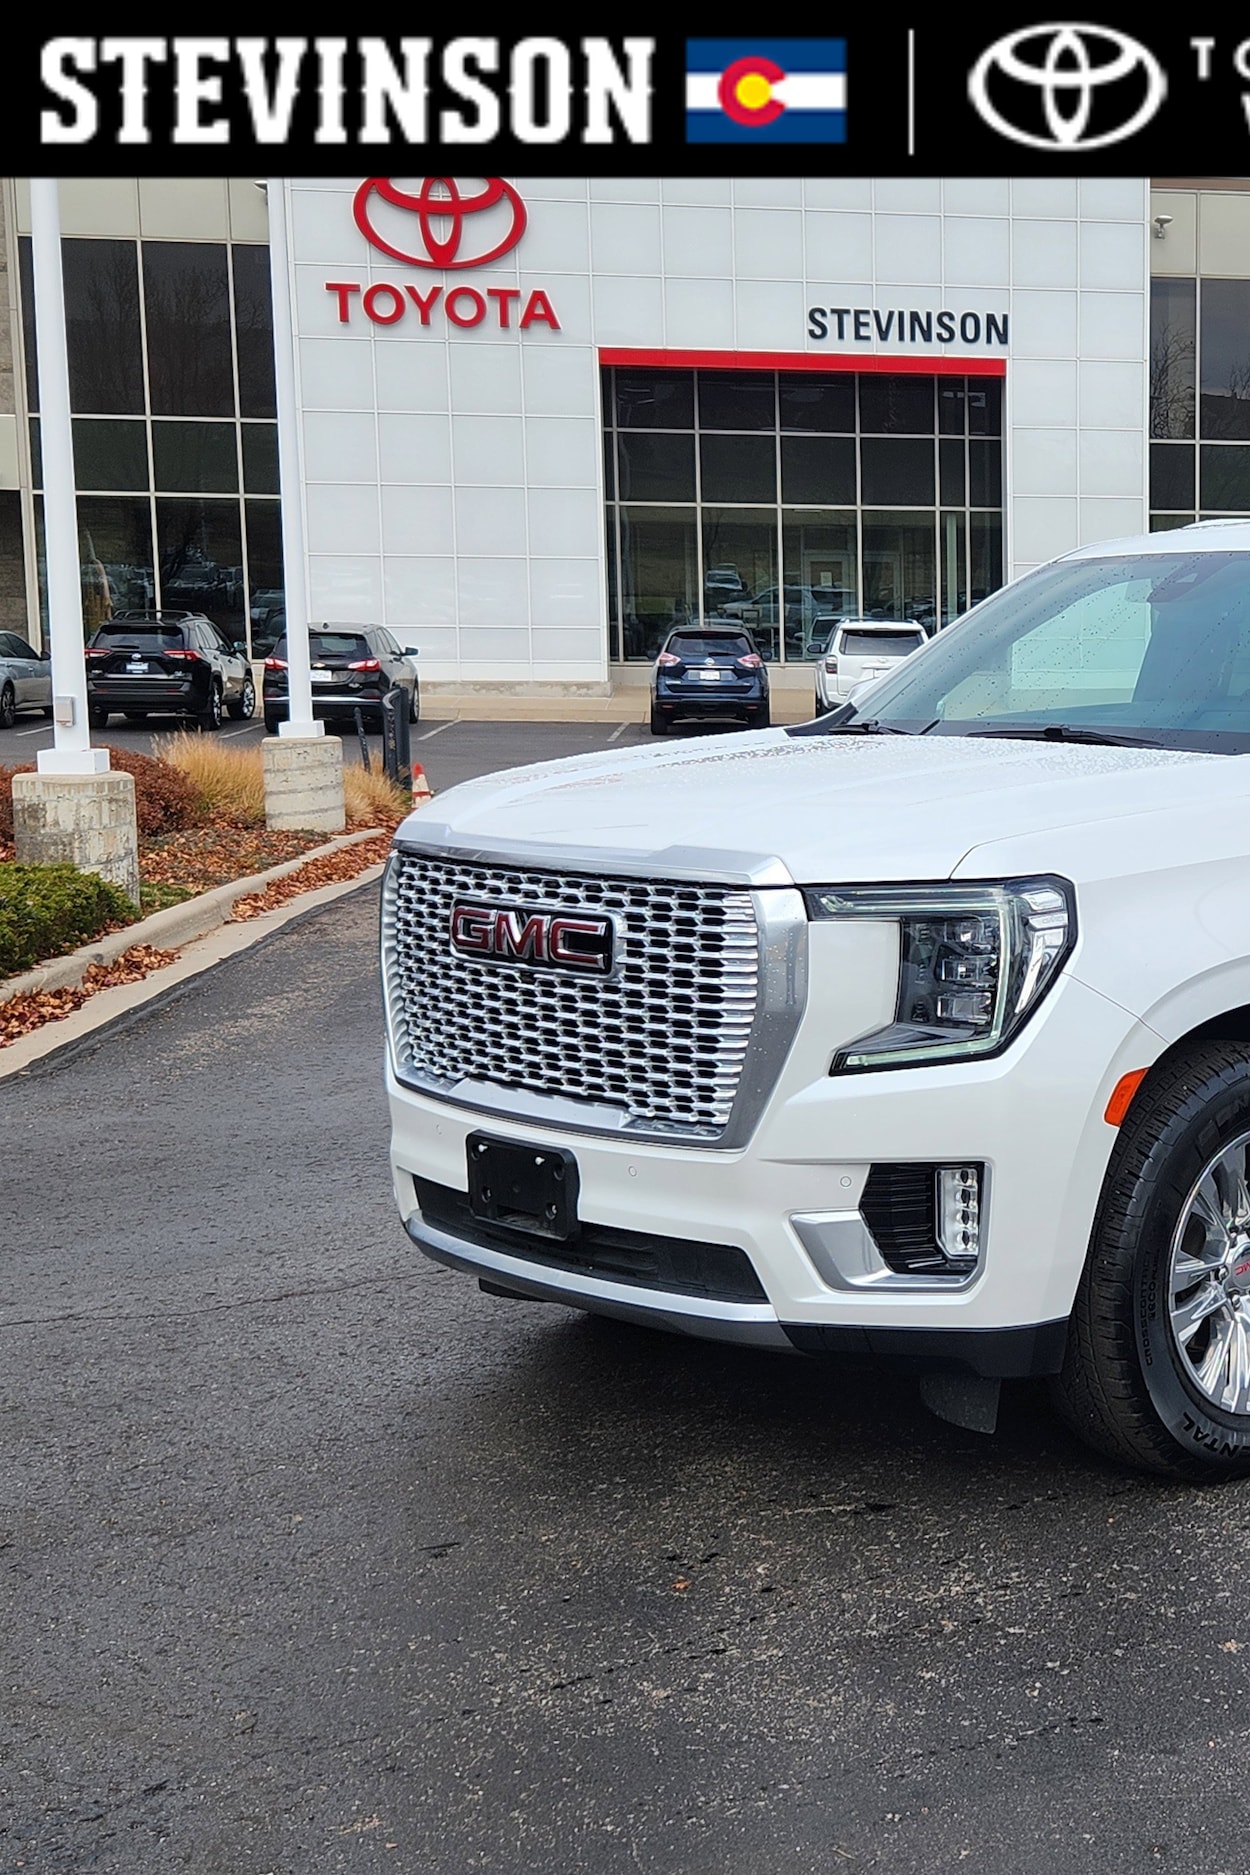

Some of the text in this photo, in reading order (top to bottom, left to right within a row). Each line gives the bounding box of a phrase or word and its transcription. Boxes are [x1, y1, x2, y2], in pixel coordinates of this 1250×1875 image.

[324, 281, 562, 331] TOYOTA
[807, 306, 1010, 346] STEVINSON
[451, 905, 607, 968] GMC
